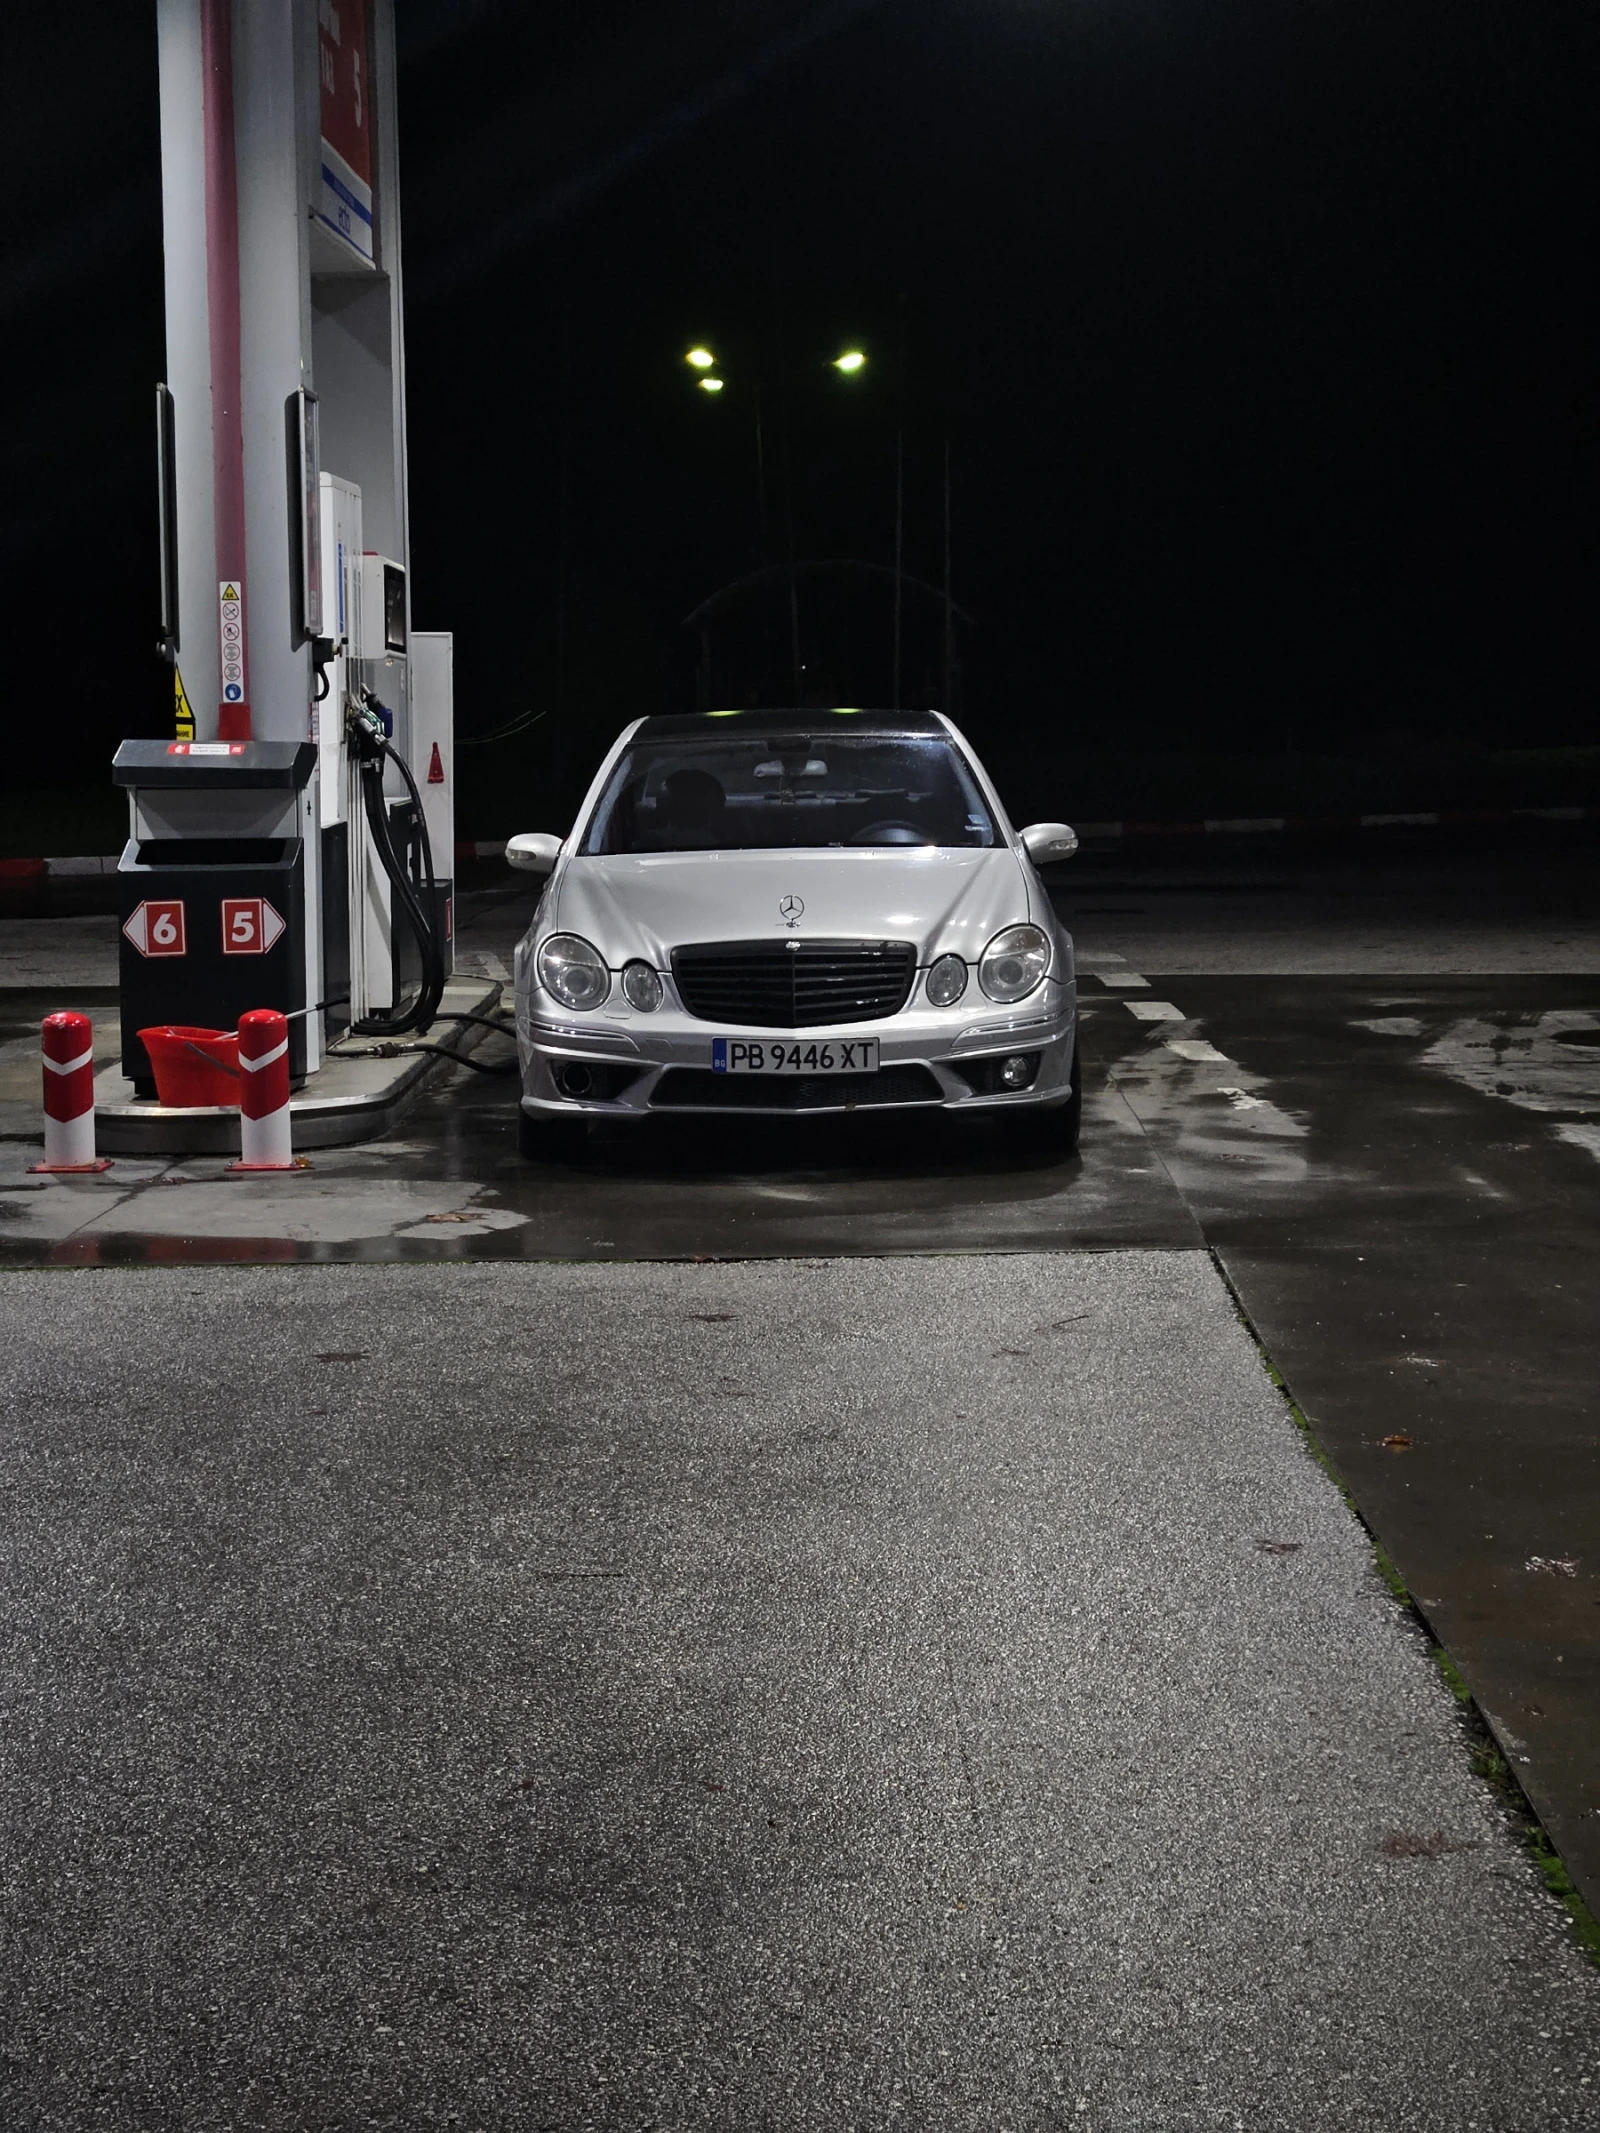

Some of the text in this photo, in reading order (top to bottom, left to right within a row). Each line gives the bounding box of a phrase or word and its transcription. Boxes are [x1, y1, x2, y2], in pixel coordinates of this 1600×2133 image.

[153, 913, 177, 945] 6
[231, 911, 255, 943] 5
[714, 1042, 874, 1071] BG PB 9446 XT
